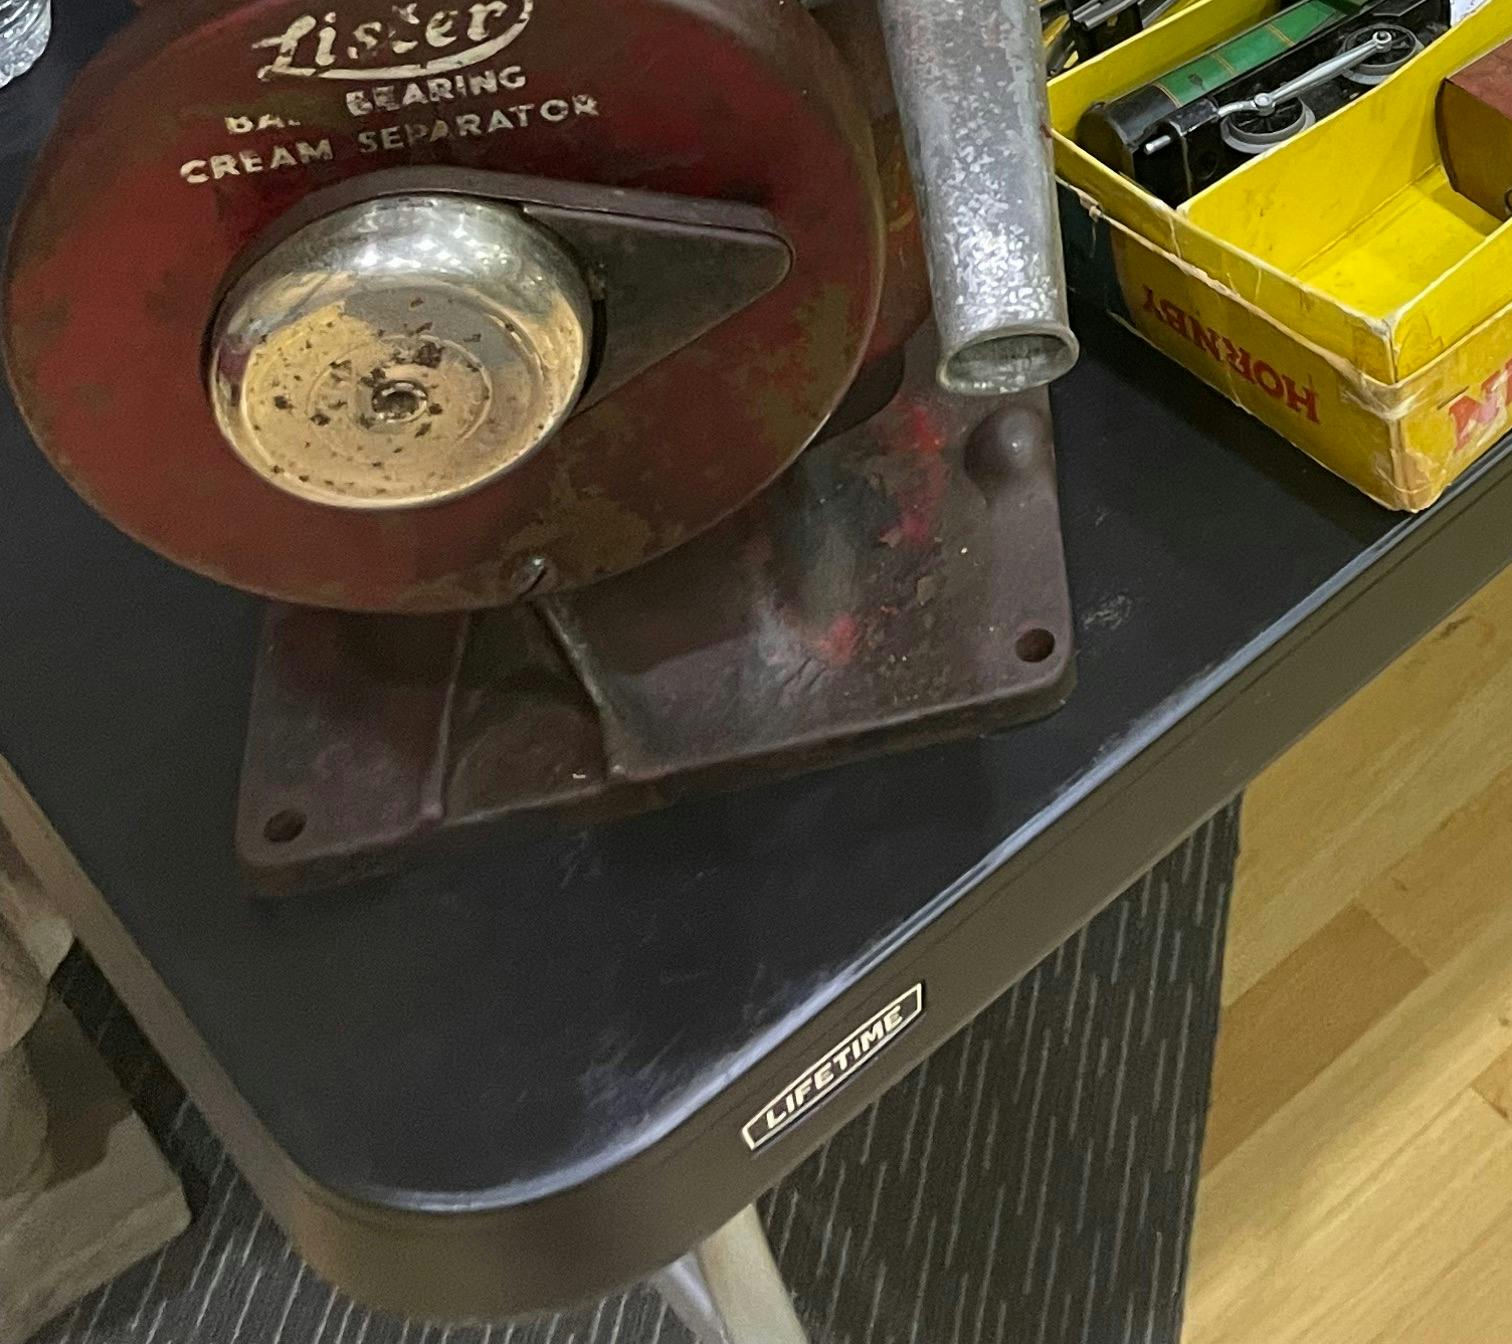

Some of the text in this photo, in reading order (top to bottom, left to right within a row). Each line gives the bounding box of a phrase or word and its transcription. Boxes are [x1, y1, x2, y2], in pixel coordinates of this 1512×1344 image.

[180, 94, 600, 184] CREAM SEPARATOR
[345, 65, 527, 117] BEARING
[1143, 284, 1320, 425] HORNBY
[766, 1004, 903, 1129] LIFETIME
